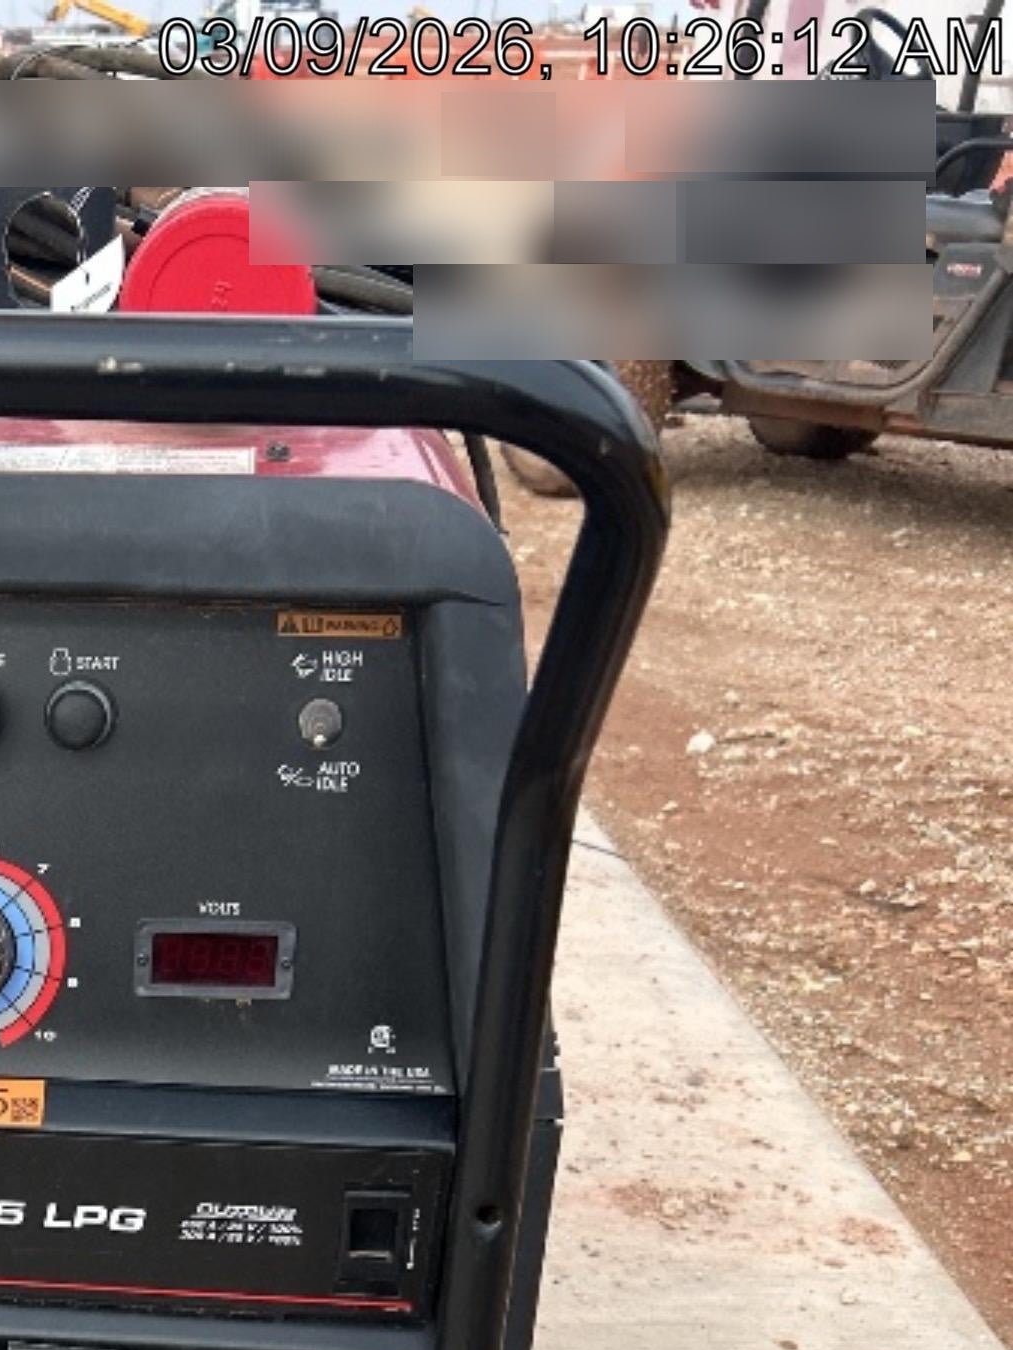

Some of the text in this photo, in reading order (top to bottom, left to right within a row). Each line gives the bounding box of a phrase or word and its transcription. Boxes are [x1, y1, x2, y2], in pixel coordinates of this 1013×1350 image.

[76, 656, 120, 671] START
[322, 650, 363, 667] HIGH
[320, 668, 353, 682] IDLE
[317, 761, 361, 777] AUTO
[316, 776, 349, 792] IDLE
[198, 900, 240, 917] VOLTS
[43, 1202, 148, 1233] LPG
